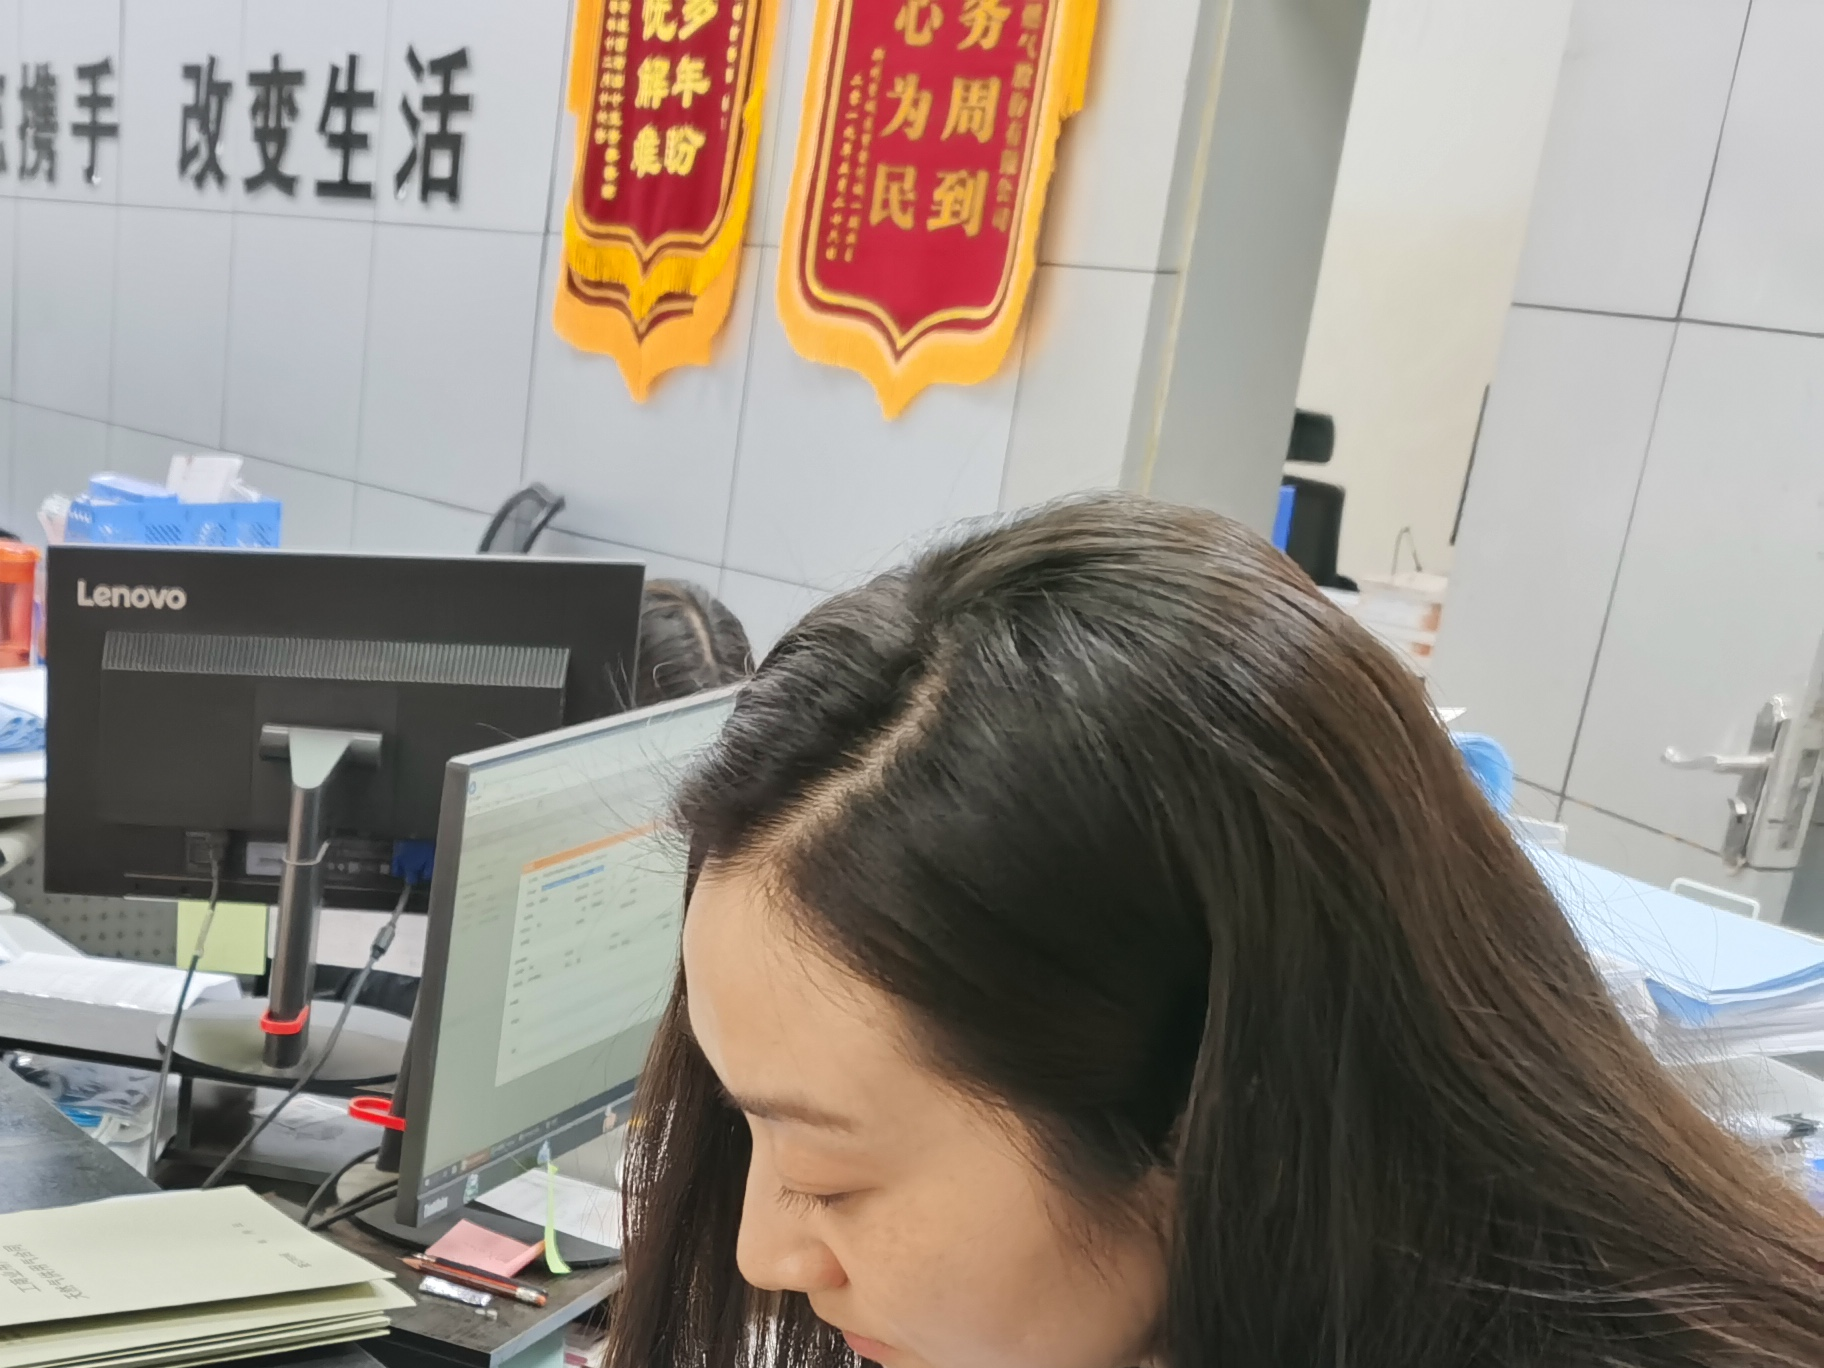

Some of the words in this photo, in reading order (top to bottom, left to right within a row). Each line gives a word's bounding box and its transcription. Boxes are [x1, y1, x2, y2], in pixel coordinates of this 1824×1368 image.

[177, 46, 475, 205] 改变生活
[869, 0, 944, 231] 心为民
[76, 579, 187, 611] Lenovo
